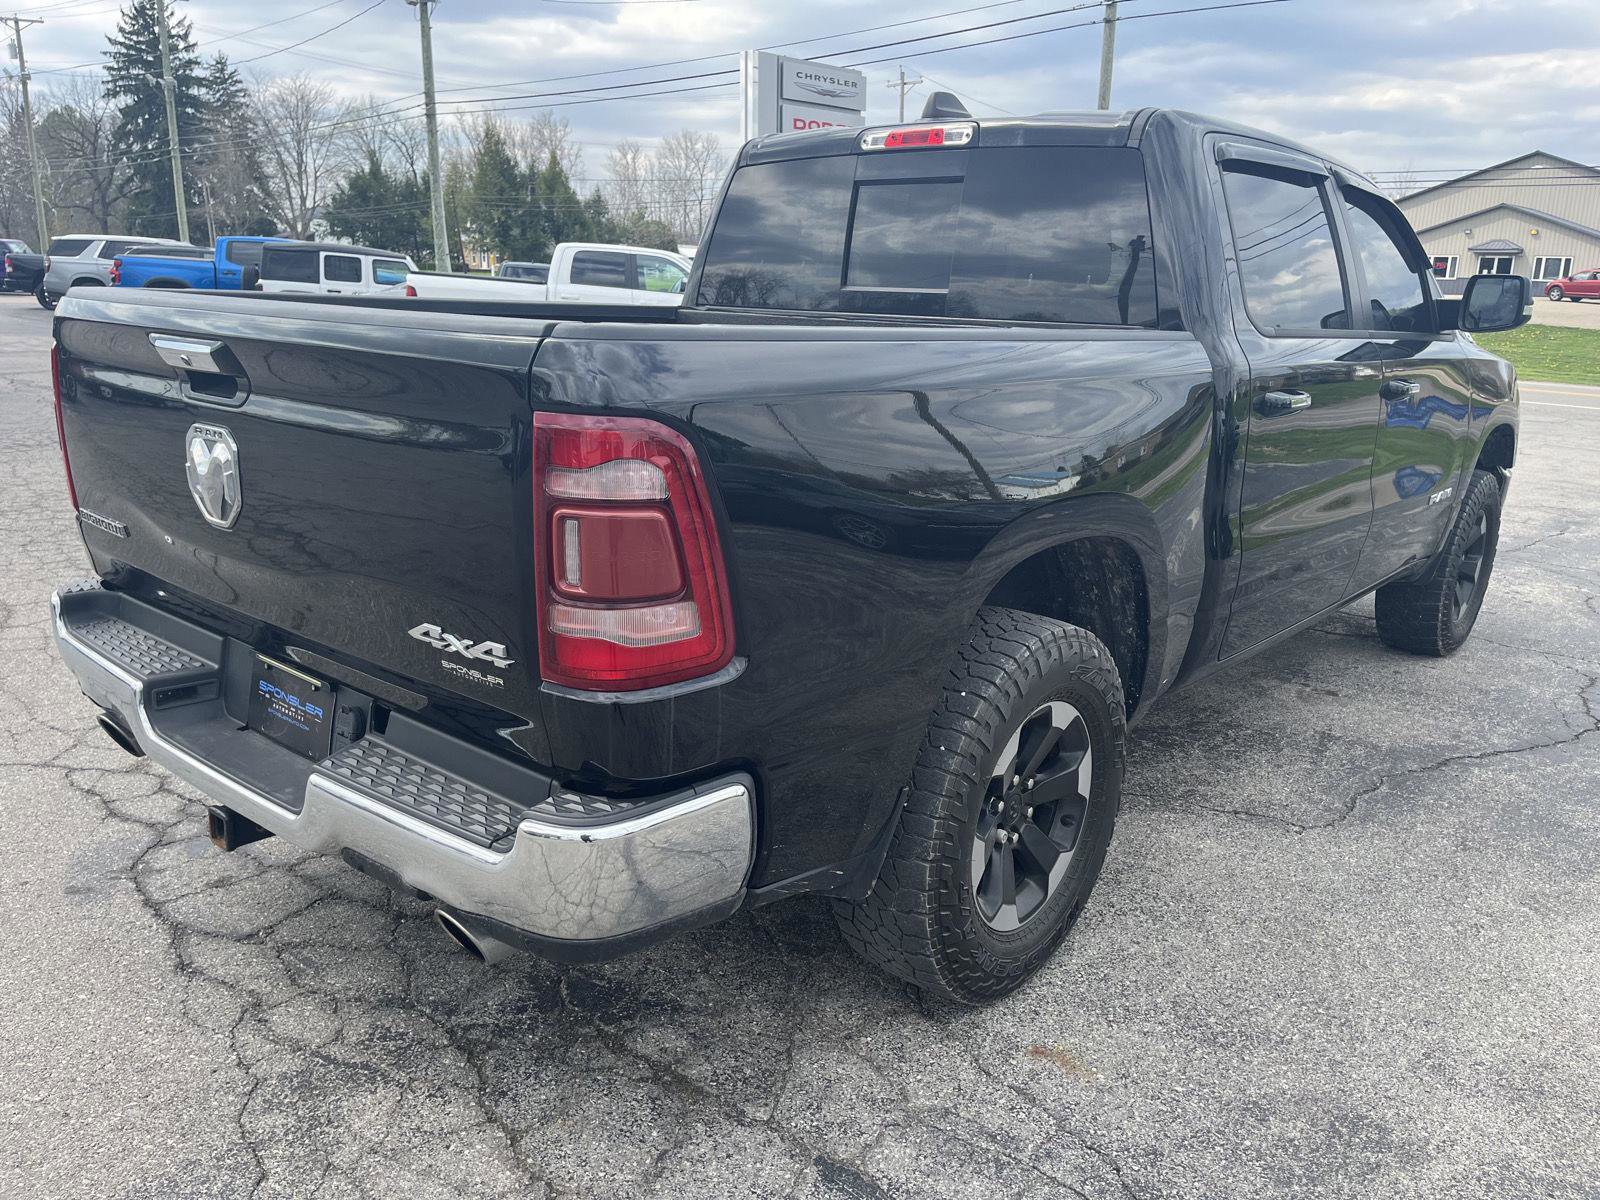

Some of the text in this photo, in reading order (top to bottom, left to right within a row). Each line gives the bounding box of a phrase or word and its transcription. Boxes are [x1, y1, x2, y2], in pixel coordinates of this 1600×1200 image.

[796, 71, 858, 89] CHRYSLER
[194, 427, 223, 439] RAM
[441, 660, 504, 686] SPONSLER
[259, 680, 323, 719] SPONSLER
